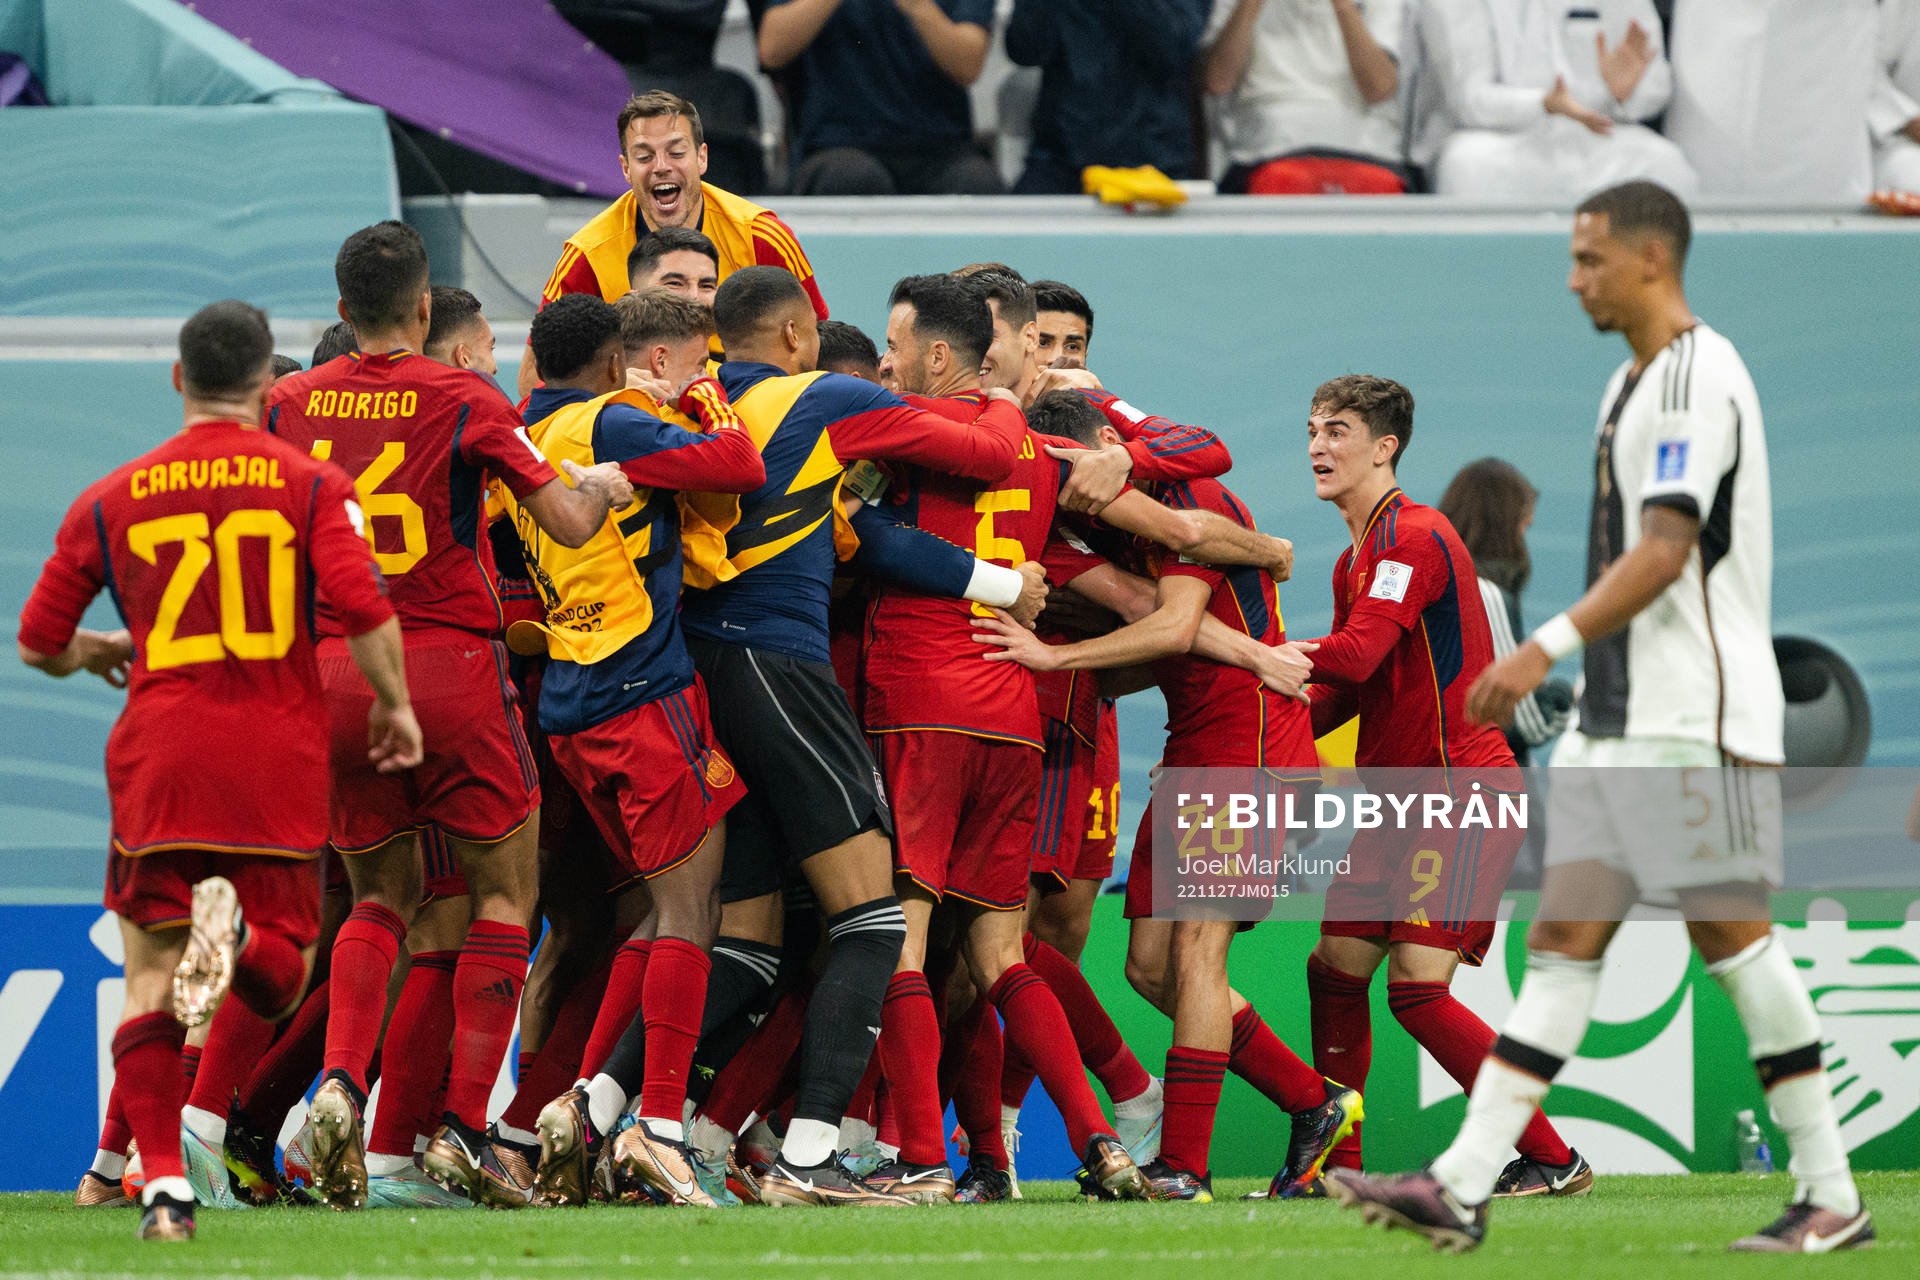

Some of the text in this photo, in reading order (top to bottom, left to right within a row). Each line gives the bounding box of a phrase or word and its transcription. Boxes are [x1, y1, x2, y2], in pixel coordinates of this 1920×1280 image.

[305, 390, 417, 419] RODRIGO
[130, 455, 285, 499] CARVAJAL
[310, 440, 428, 575] 6
[971, 489, 1030, 619] 5
[127, 509, 296, 671] 20
[577, 602, 605, 620] CUP
[1680, 765, 1712, 828] 5
[1178, 800, 1244, 859] 26
[1409, 850, 1443, 902] 9
